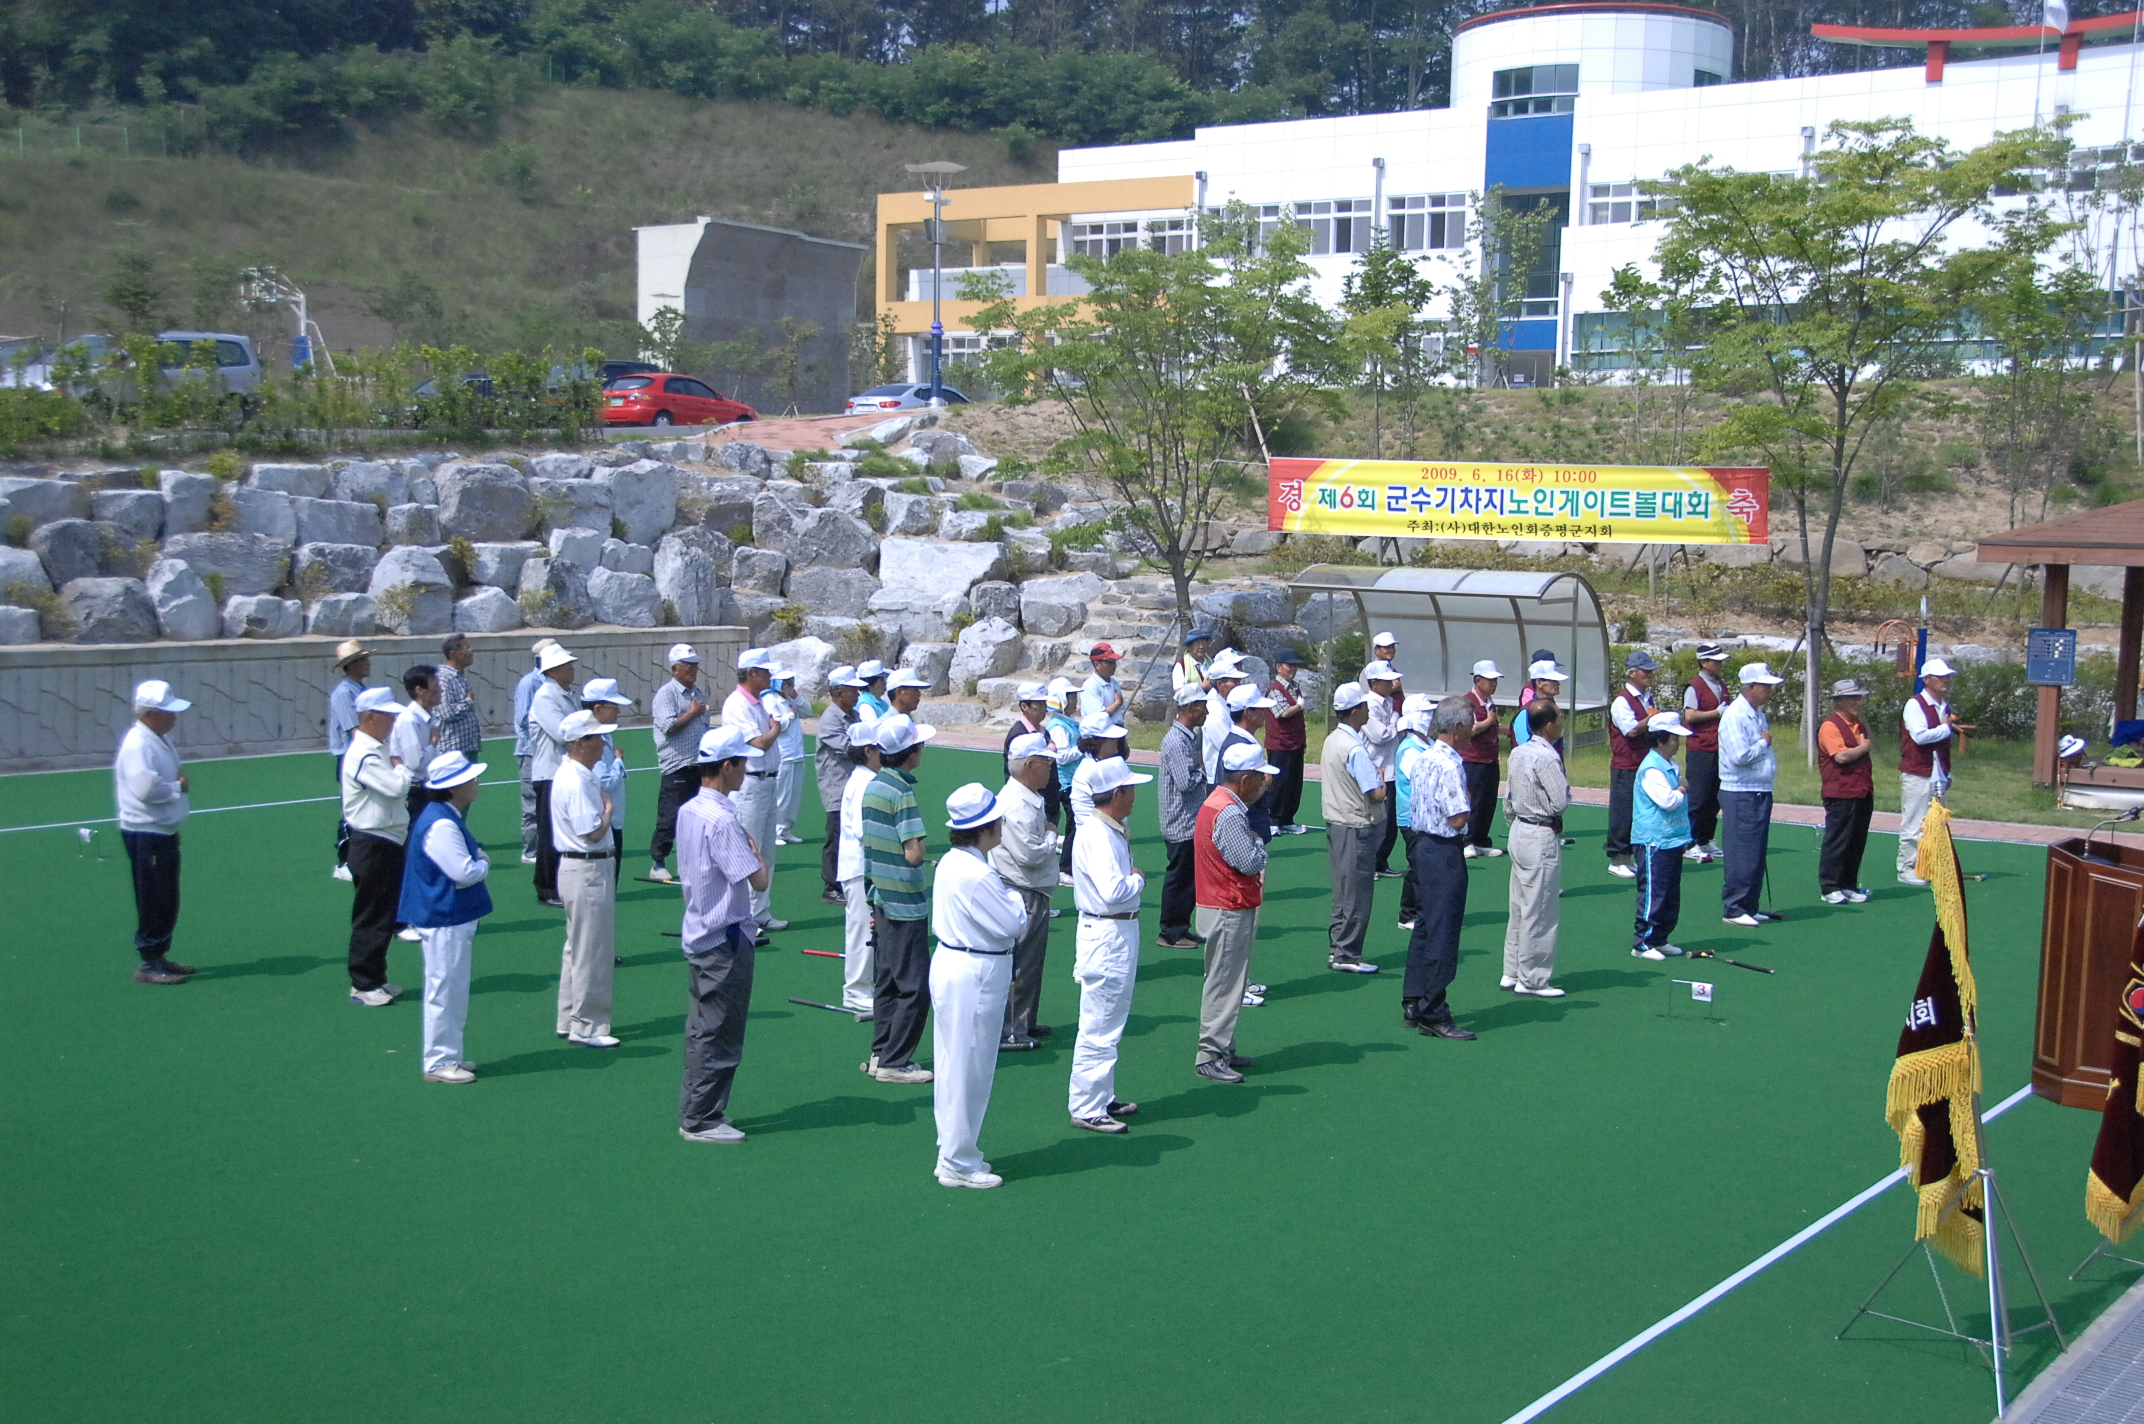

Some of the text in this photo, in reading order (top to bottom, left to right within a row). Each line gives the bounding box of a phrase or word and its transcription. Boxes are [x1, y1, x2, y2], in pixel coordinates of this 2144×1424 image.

[1421, 467, 1597, 484] 2009. 6. 16(화) 10:00
[1278, 480, 1304, 513] 경
[1318, 485, 1710, 519] 제6회 군수기차지노인게이트볼대회
[1726, 489, 1759, 524] 축
[1697, 984, 1706, 995] 3
